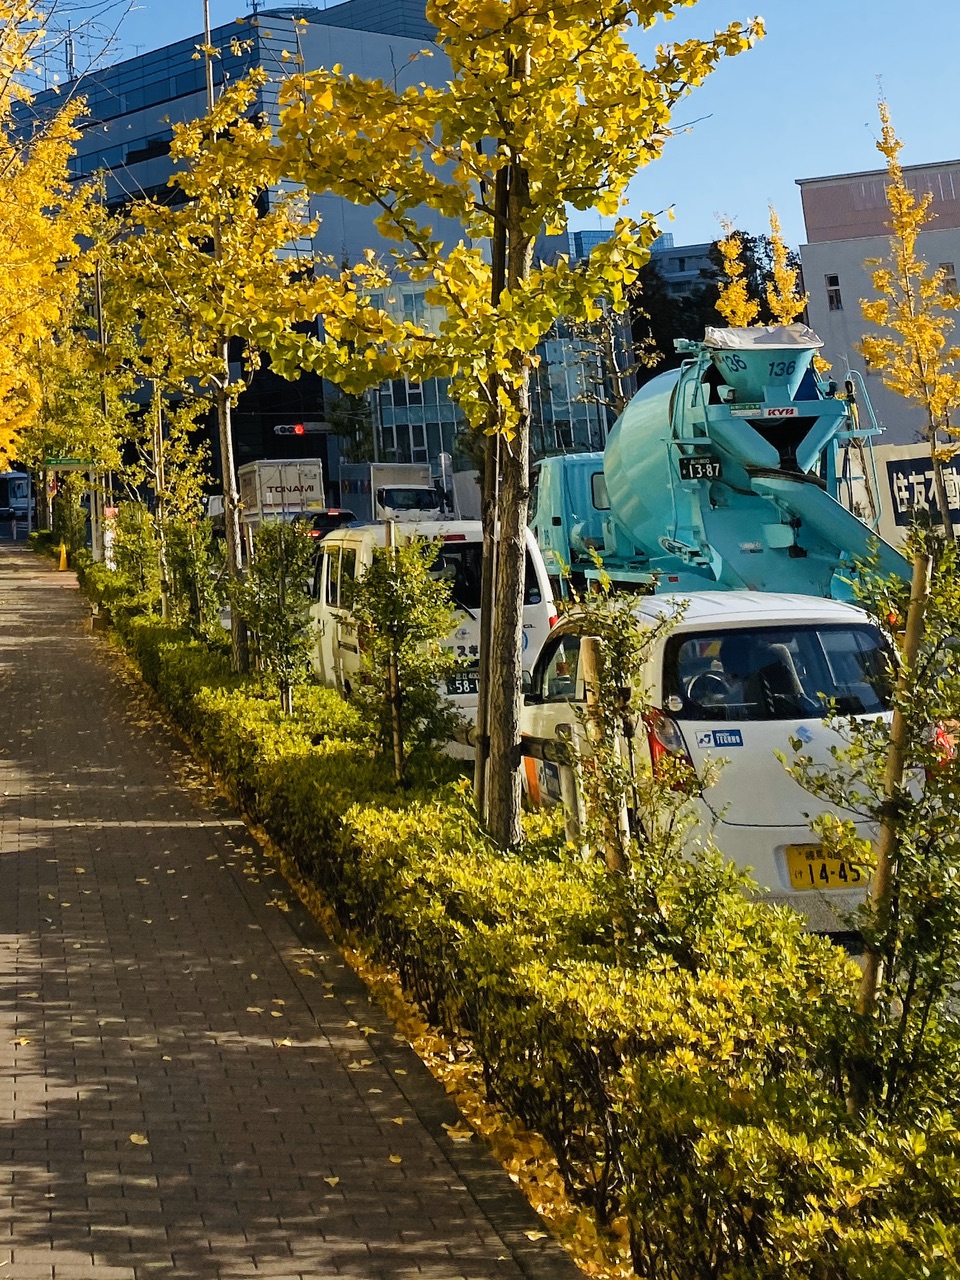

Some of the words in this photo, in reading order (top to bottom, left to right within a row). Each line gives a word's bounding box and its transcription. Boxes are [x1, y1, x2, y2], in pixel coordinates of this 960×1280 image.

[722, 354, 747, 373] 136
[768, 361, 796, 377] 136
[266, 484, 315, 493] TONAMI
[808, 862, 861, 885] 14-45
